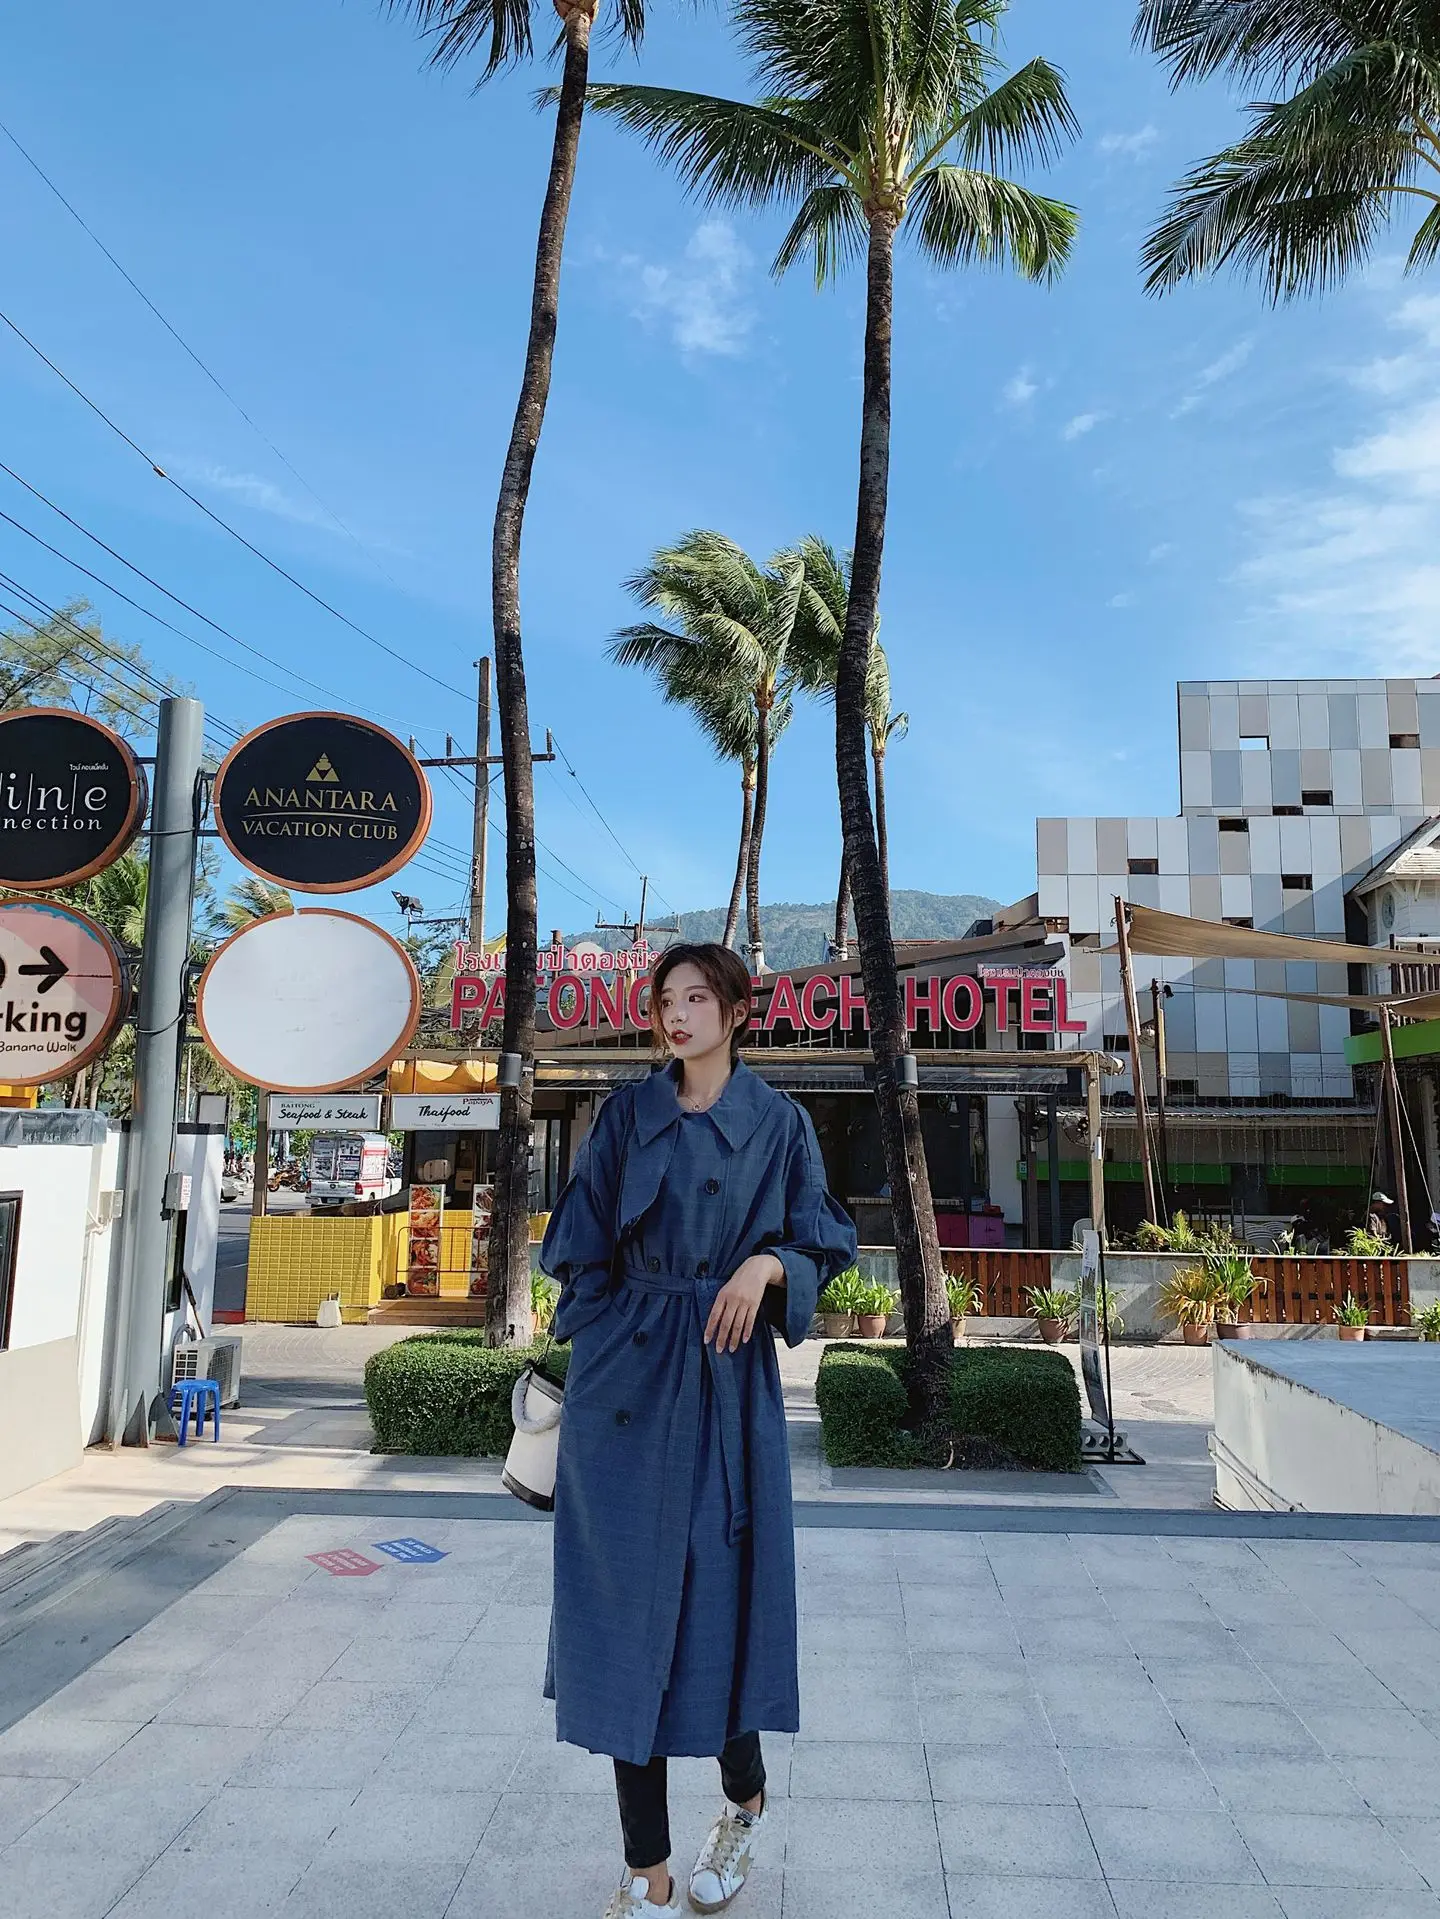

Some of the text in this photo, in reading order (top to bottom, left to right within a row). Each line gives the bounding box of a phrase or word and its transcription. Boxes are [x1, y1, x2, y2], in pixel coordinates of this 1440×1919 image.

[244, 787, 399, 812] ANANTARA
[241, 821, 398, 840] VACATION CLUB
[451, 976, 652, 1030] PAONG
[904, 975, 1087, 1033] HOTEL
[0, 1001, 86, 1041] king
[46, 1041, 77, 1053] Walk
[278, 1107, 368, 1125] Seafood & Steak
[418, 1105, 470, 1123] Thaifood
